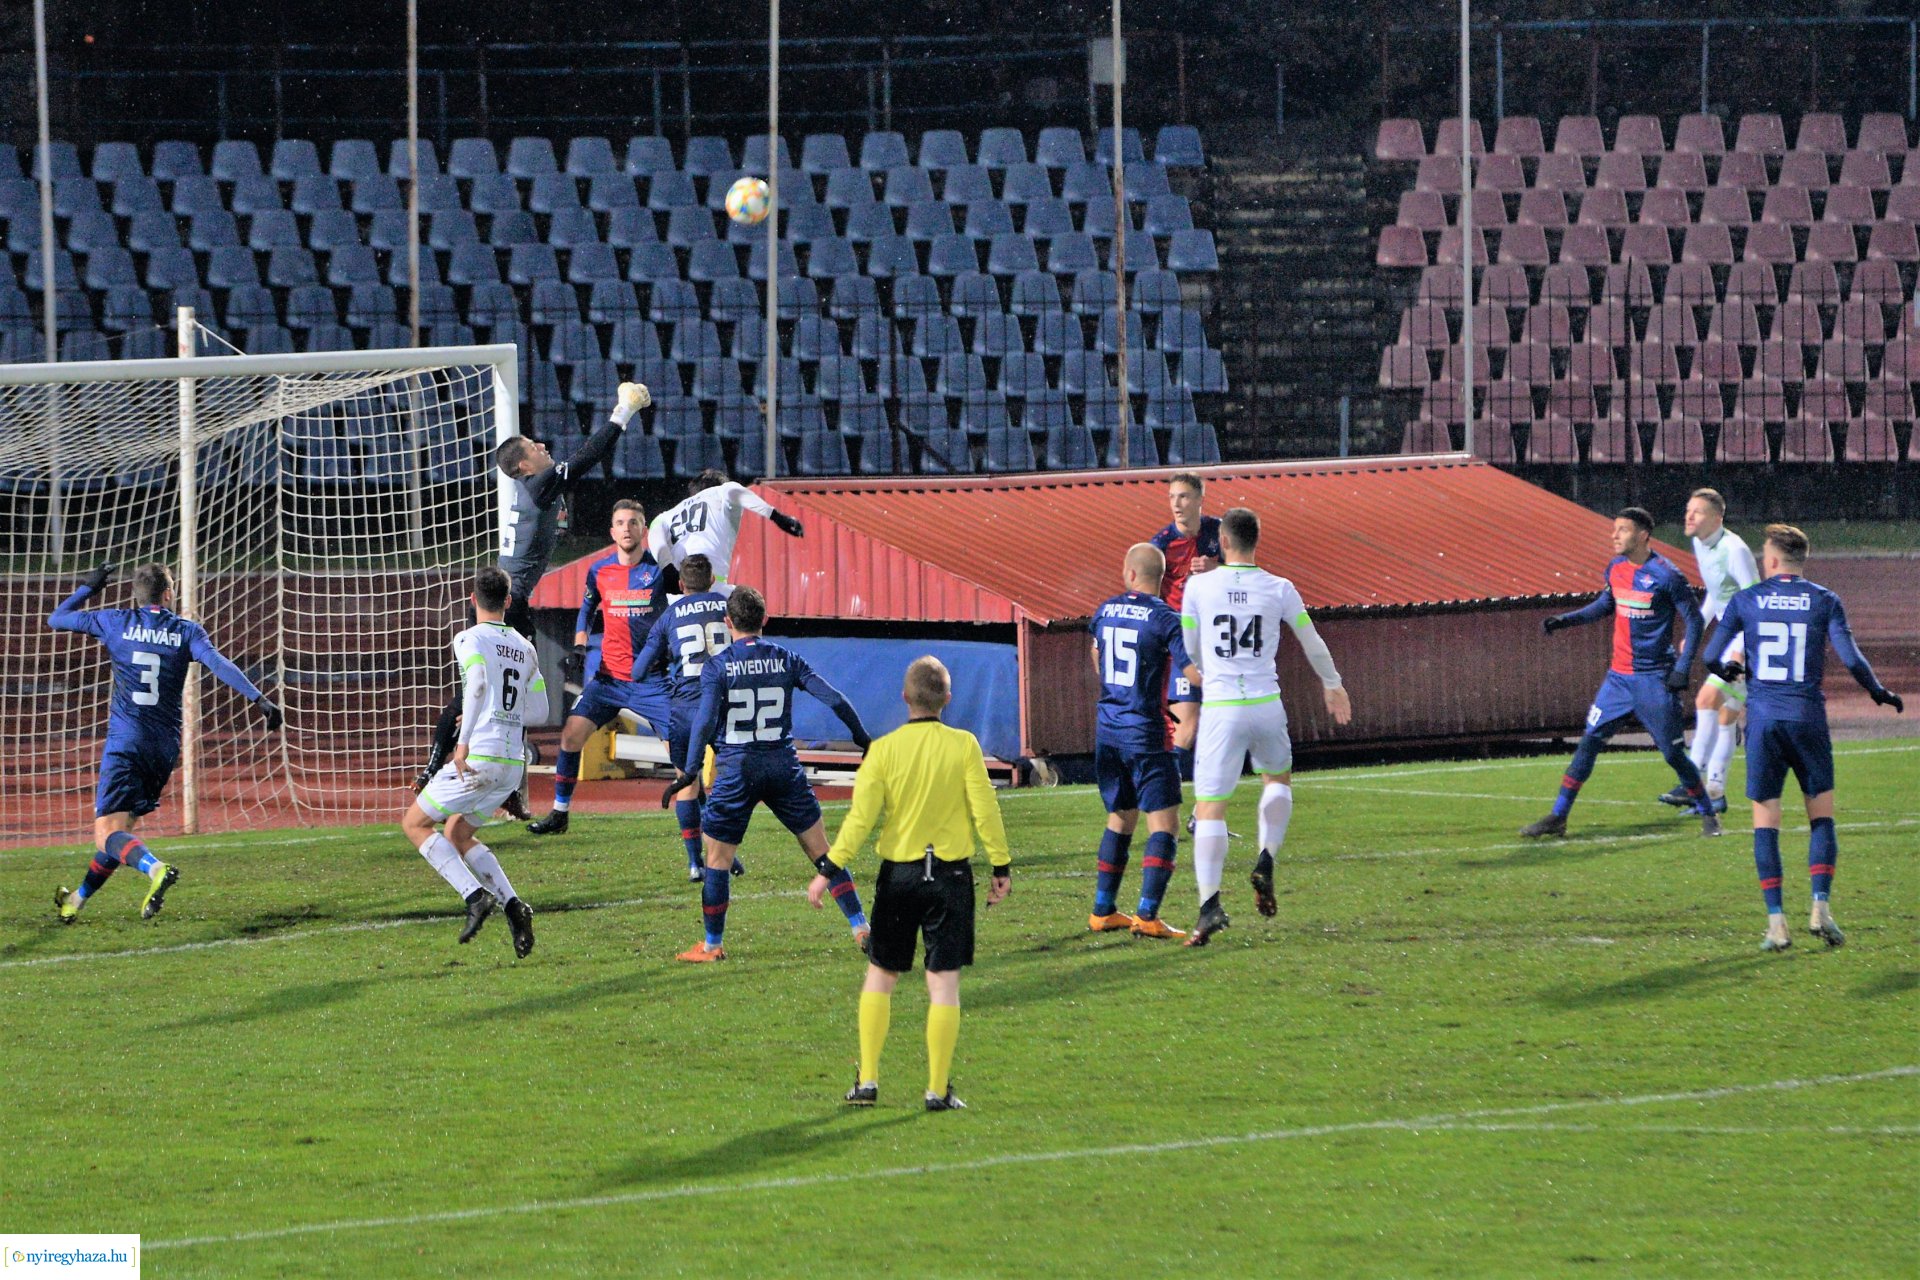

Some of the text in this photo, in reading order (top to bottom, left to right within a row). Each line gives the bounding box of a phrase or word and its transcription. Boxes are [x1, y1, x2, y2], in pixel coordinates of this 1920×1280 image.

[670, 501, 708, 545] 20
[1102, 604, 1153, 622] PAPUCSEK
[1227, 592, 1248, 604] TAR
[122, 624, 181, 647] JÁNVÁRI
[1102, 626, 1139, 687] 15
[1213, 614, 1263, 658] 34
[1757, 622, 1807, 682] 21
[131, 651, 161, 706] 3
[725, 658, 786, 677] SHVEDYUK
[1175, 677, 1190, 696] 18
[502, 668, 520, 712] 6
[726, 686, 785, 744] 22
